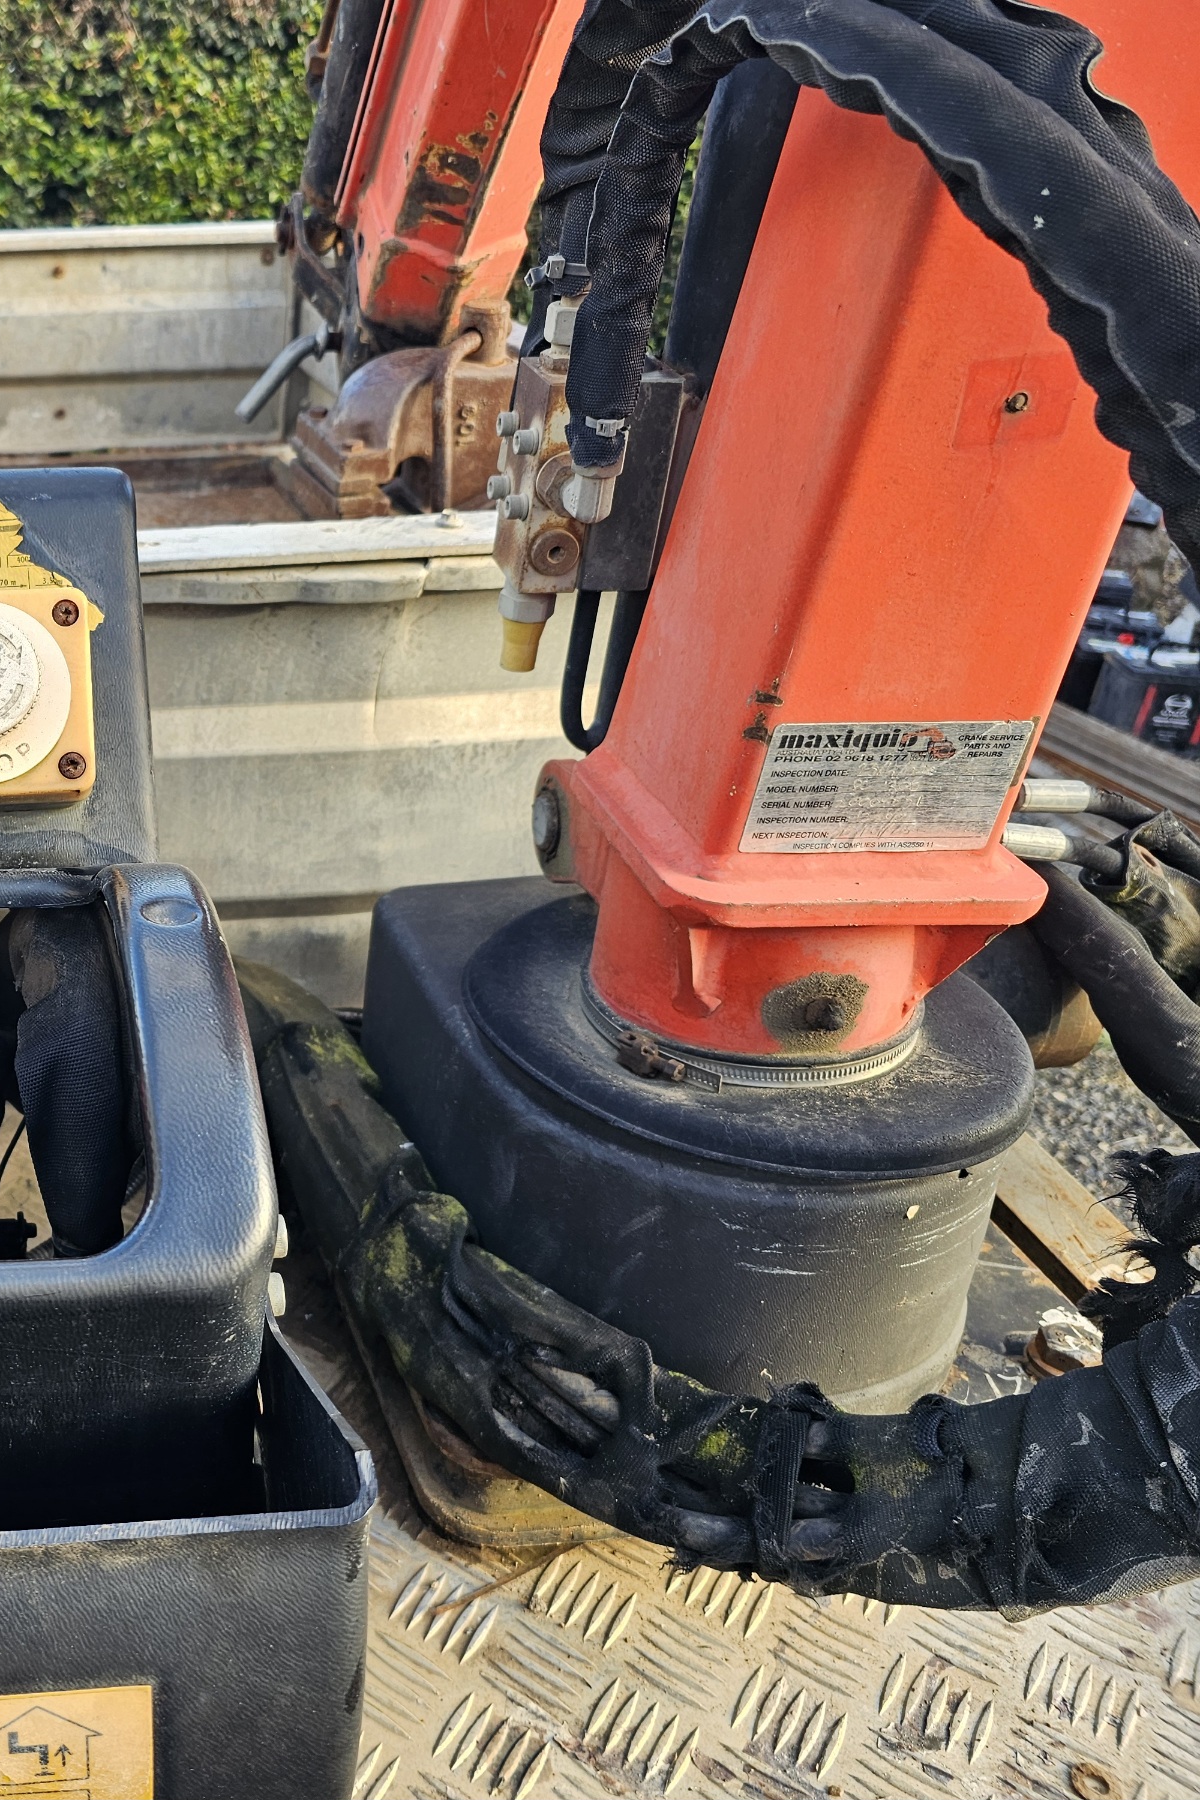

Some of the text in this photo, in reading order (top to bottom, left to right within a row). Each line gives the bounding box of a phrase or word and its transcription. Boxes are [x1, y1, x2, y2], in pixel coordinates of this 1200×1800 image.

[778, 729, 918, 752] maxiquip
[958, 734, 987, 742] CRANE
[774, 755, 822, 763] PHONE
[879, 754, 908, 762] 1277
[770, 770, 823, 778] INSPECTION
[824, 769, 849, 777] DATE:
[765, 785, 839, 794] MODEL NUMBER:
[761, 801, 791, 809] SERIAL
[756, 816, 808, 824] INSPECTION
[775, 831, 829, 839] INSPECTION:
[792, 842, 837, 850] INSPECTION
